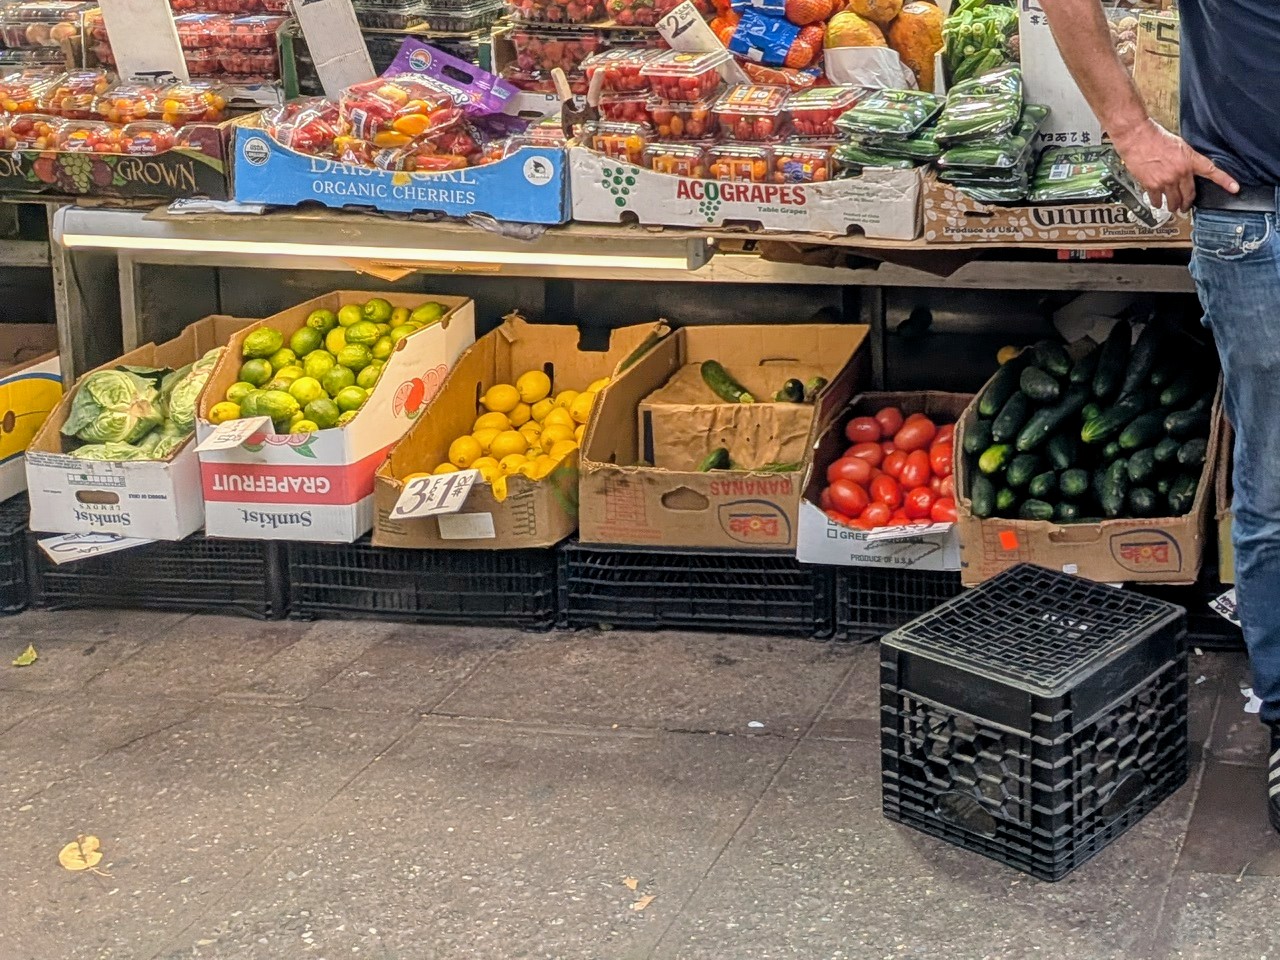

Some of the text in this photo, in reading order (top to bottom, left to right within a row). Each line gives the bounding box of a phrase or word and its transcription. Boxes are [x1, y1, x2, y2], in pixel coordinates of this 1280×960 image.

[117, 156, 197, 191] GROWN
[312, 180, 476, 205] ORGANIC CHERRIES
[676, 179, 807, 206] ACOGRAPES
[757, 206, 807, 216] Table Grapes
[944, 226, 1020, 235] Produce of USA
[1102, 227, 1136, 236] Premium
[212, 473, 331, 495] GRAPEFRUIT
[710, 478, 792, 497] BANANAS
[396, 478, 429, 515] 3
[74, 507, 131, 526] Sunkist
[79, 503, 122, 512] LEMONS
[241, 507, 313, 529] Sunkist
[728, 514, 779, 537] Dole
[839, 531, 868, 541] GREE
[850, 553, 892, 563] PRODUCE OF
[1119, 544, 1169, 564] Dole
